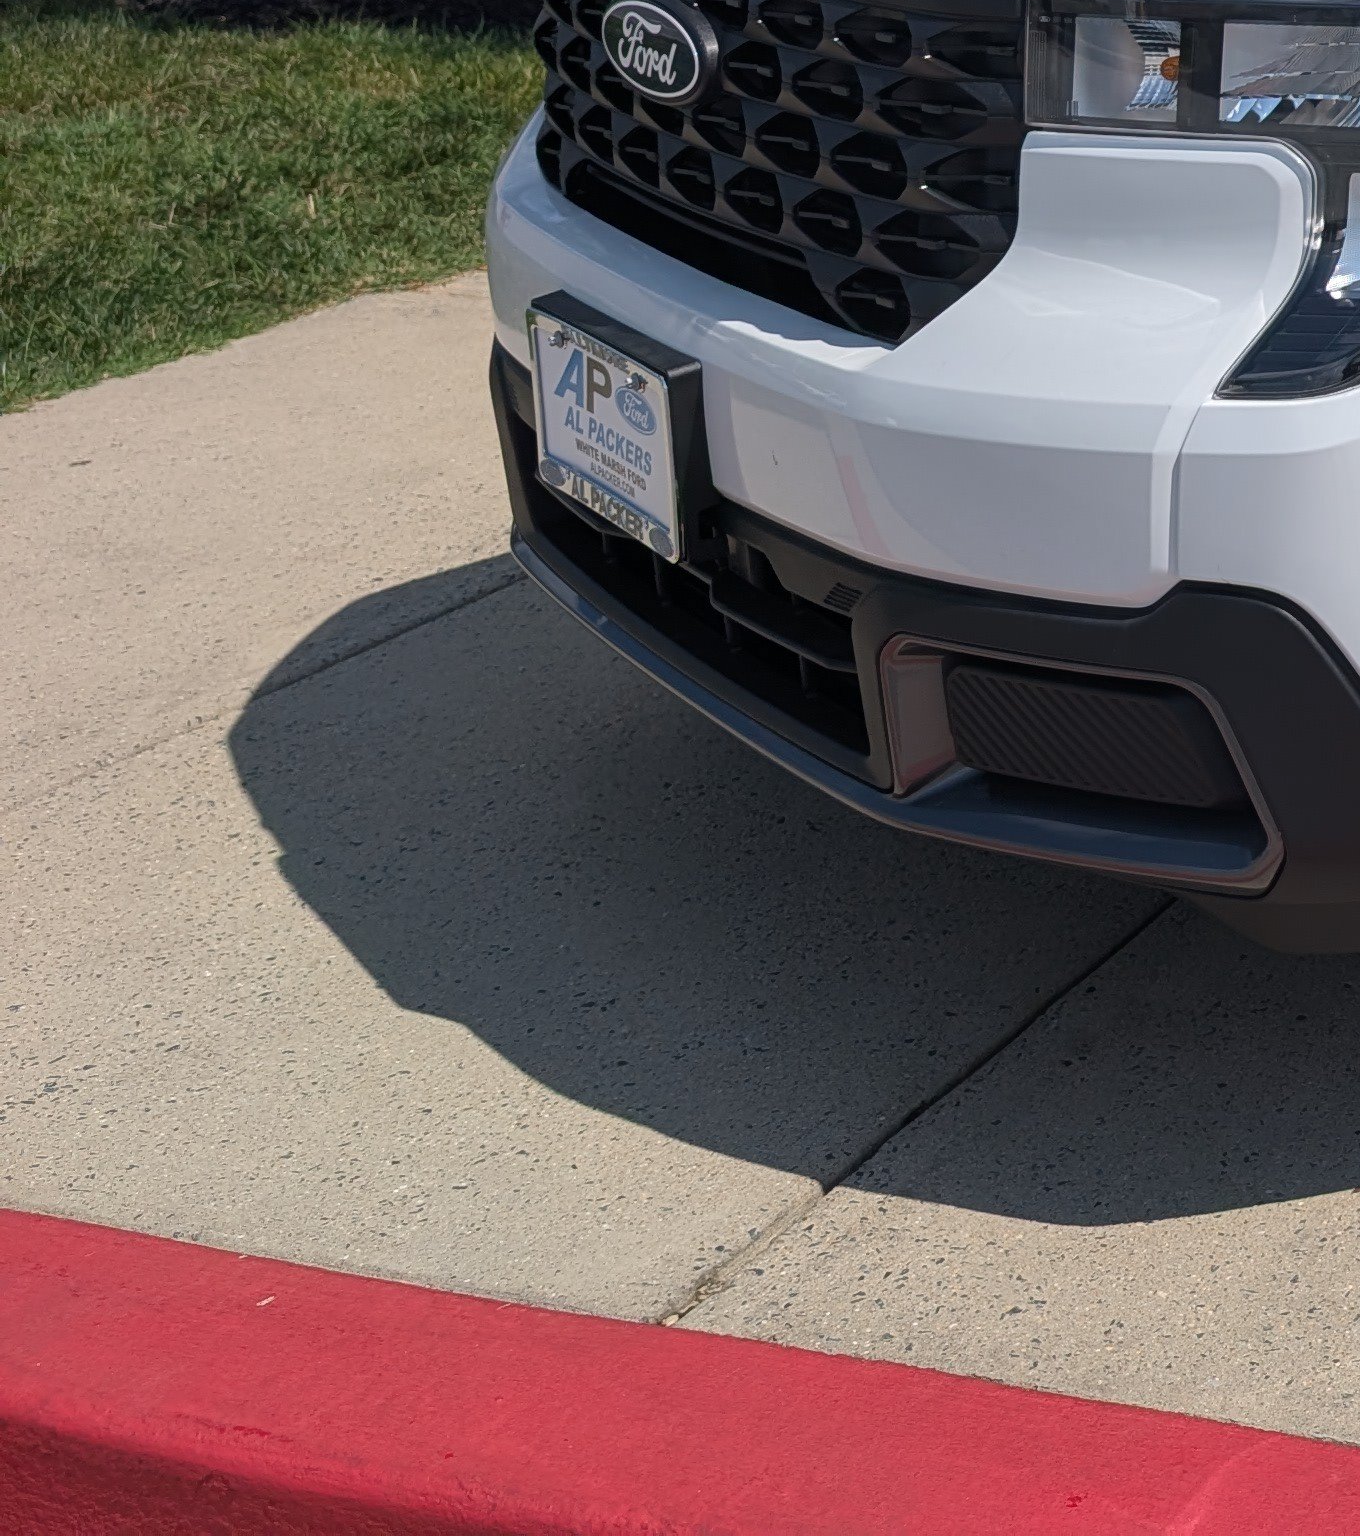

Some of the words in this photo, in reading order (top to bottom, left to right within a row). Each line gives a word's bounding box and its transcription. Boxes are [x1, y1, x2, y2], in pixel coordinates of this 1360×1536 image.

[617, 10, 678, 86] Ford
[554, 348, 613, 414] AP
[564, 406, 584, 435] AL
[588, 416, 652, 476] PACKERS
[574, 437, 600, 463] WHITE
[627, 467, 647, 491] FORD
